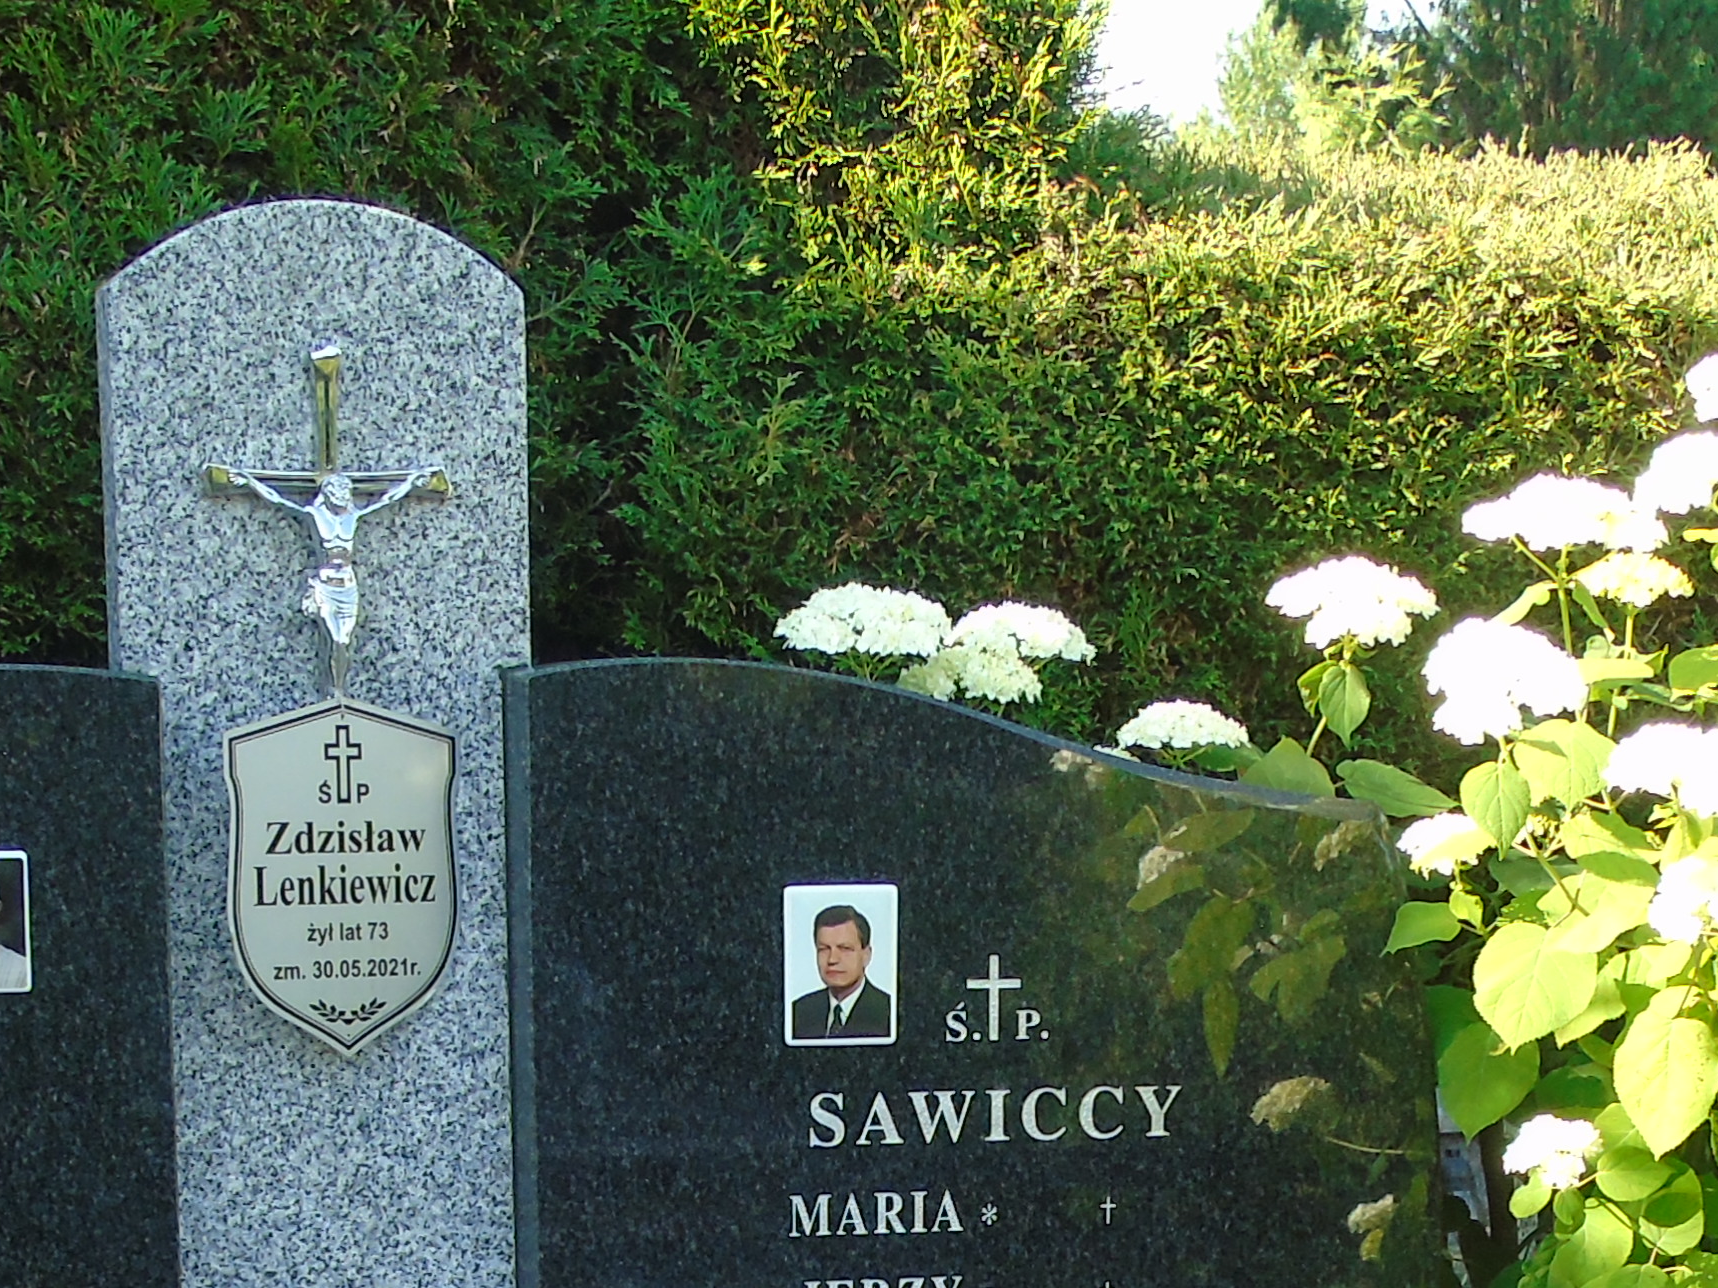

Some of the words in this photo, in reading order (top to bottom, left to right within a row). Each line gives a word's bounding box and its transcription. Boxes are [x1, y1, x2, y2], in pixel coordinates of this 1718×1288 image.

[318, 780, 332, 804] Ś
[357, 783, 370, 804] P
[265, 820, 426, 855] Zdzisław
[253, 863, 436, 906] Lenkiewicz
[307, 922, 333, 947] żył
[340, 922, 362, 941] lat
[367, 922, 389, 940] 73
[273, 964, 306, 980] zm.
[312, 958, 421, 979] 30.05.2021r.
[808, 1084, 1181, 1148] SAWICCY
[788, 1188, 965, 1238] MARIA
